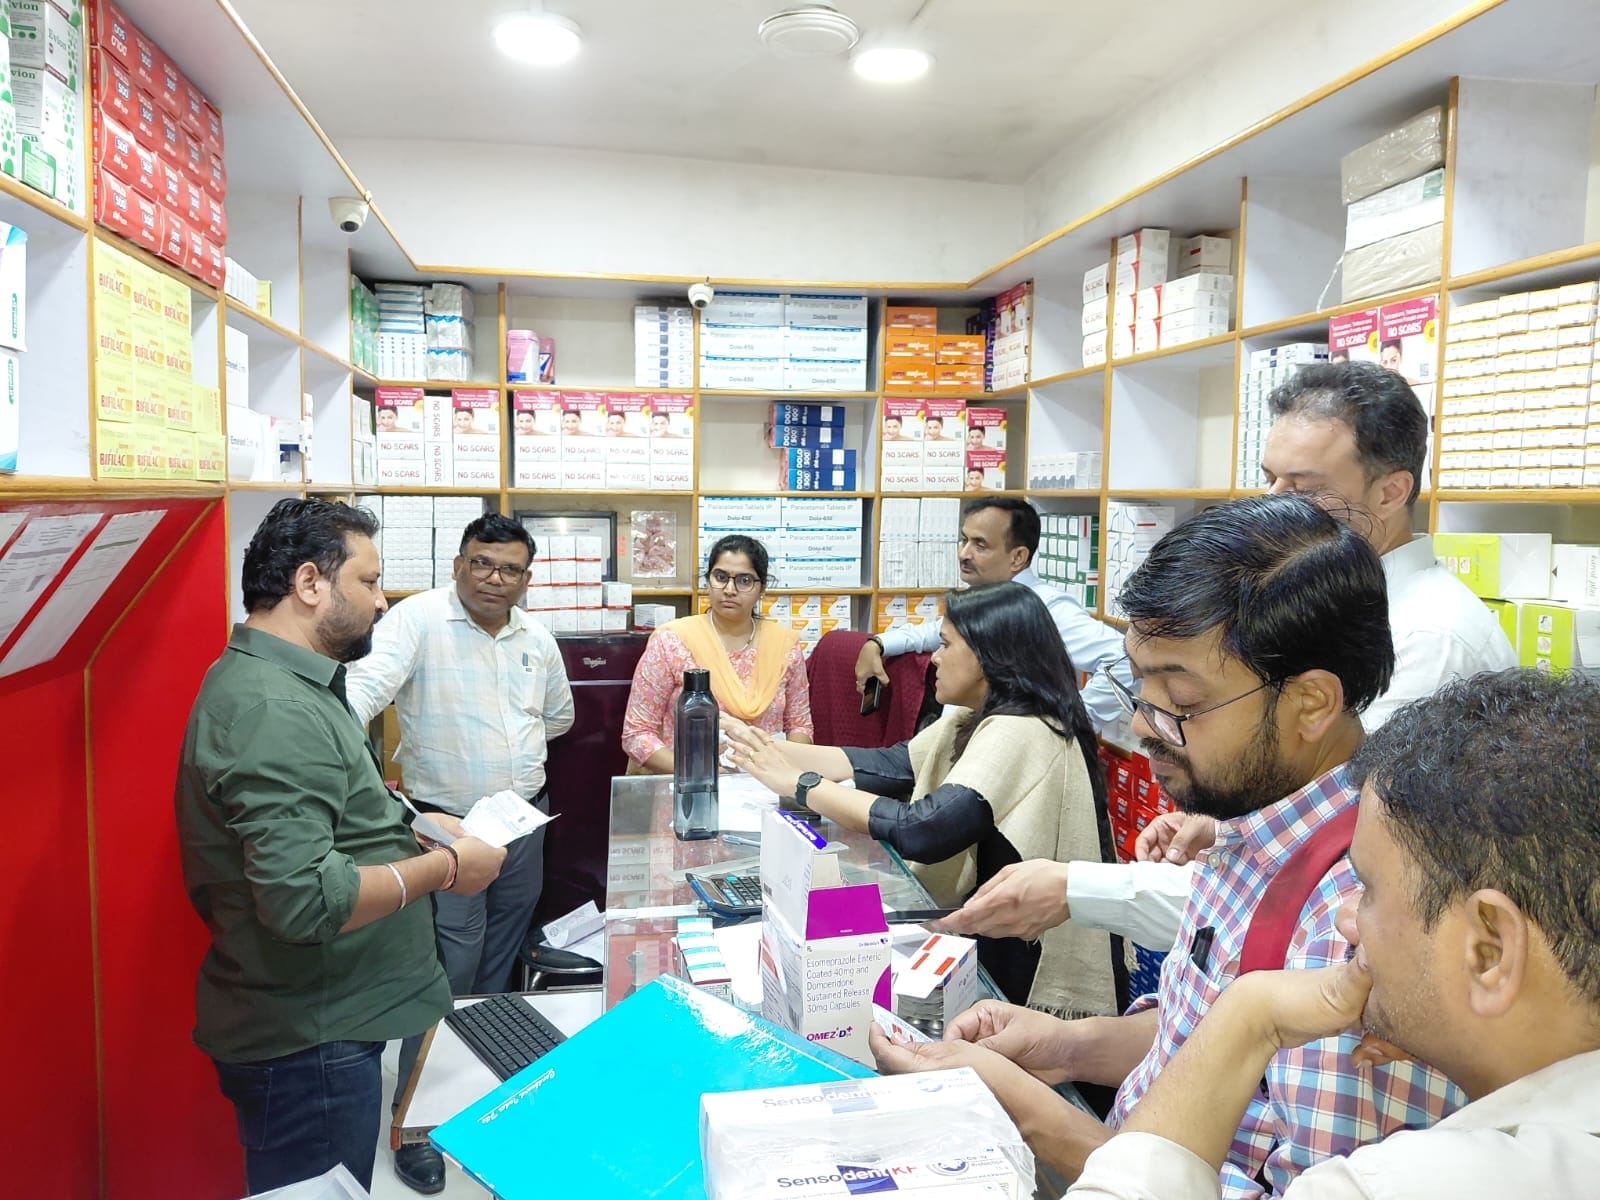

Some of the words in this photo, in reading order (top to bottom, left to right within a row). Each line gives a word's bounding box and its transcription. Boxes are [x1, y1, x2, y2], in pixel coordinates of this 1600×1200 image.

[11, 70, 36, 79] vion
[99, 273, 122, 294] BIFILAC
[1388, 327, 1397, 337] NO
[1336, 338, 1345, 347] NO
[433, 401, 440, 410] NO
[434, 446, 440, 456] NO
[100, 453, 125, 466] BIFILAC
[806, 955, 856, 968] Esomeprazole
[858, 952, 881, 964] Enteric
[806, 969, 832, 980] Coated
[834, 967, 854, 977] 40mg
[856, 966, 869, 974] and
[806, 980, 854, 990] Domperidone
[806, 990, 842, 1002] Sustained
[844, 988, 870, 998] Release
[806, 1004, 828, 1014] 30mg
[830, 1000, 860, 1012] Capsules
